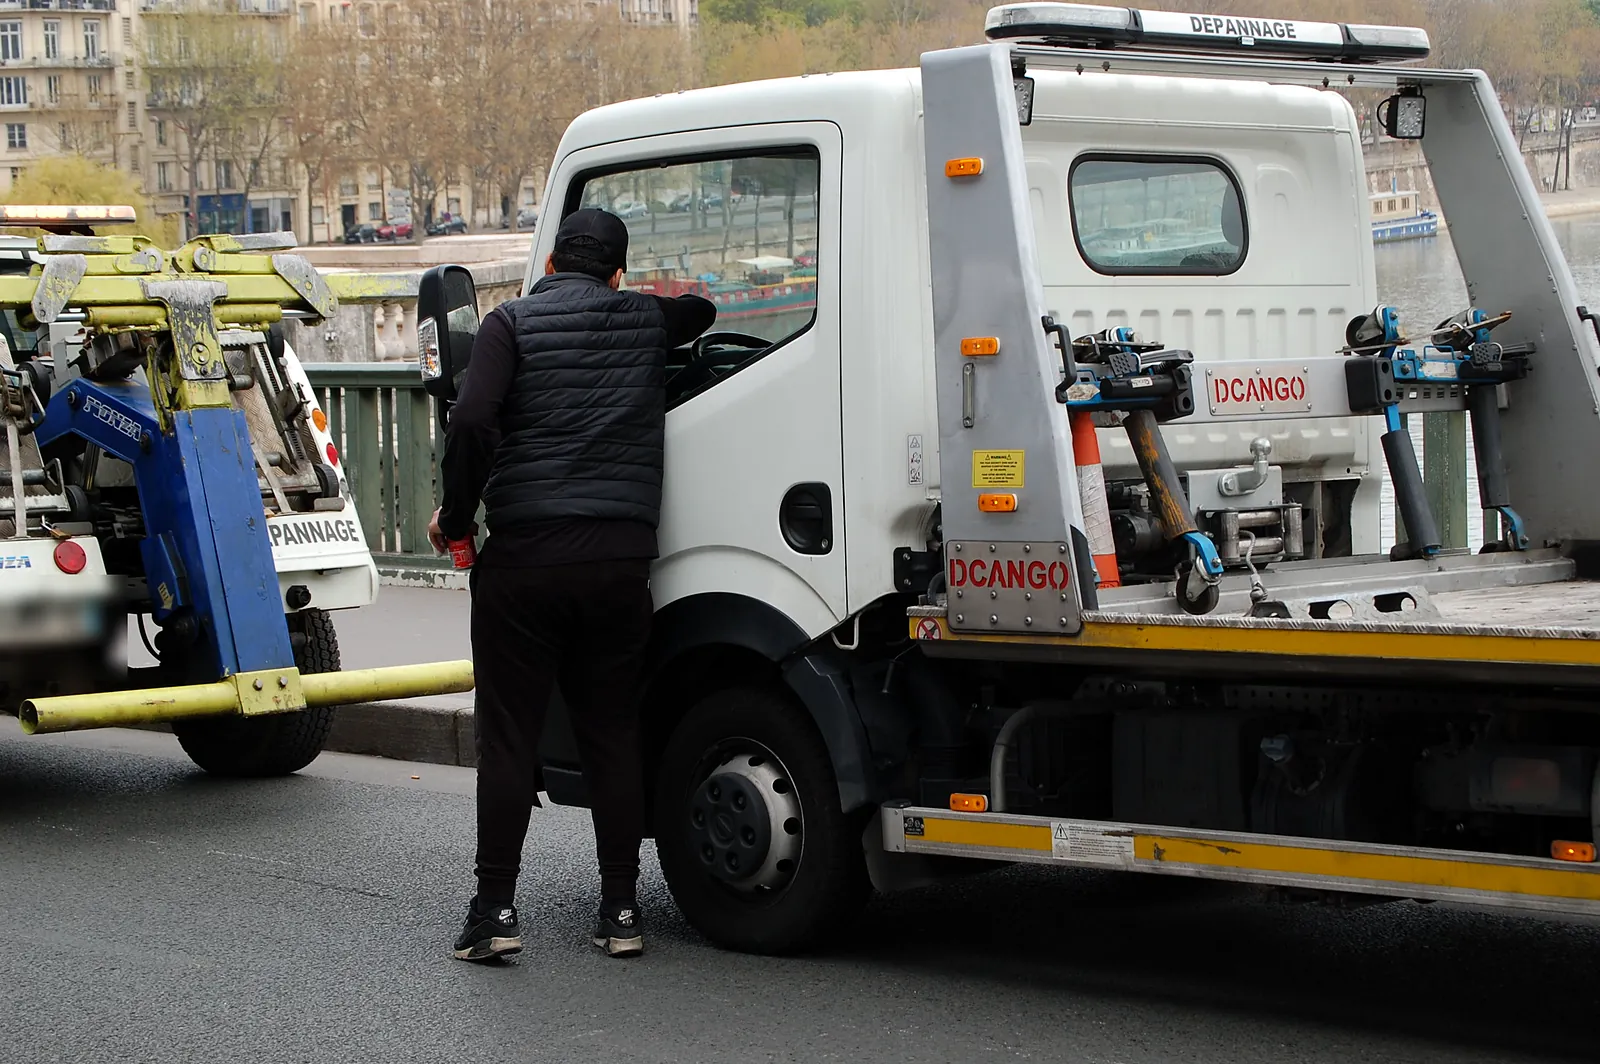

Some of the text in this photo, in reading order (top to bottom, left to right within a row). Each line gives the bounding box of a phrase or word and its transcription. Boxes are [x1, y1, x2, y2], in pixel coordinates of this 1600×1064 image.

[1190, 16, 1296, 39] DEPANNAGE
[1215, 376, 1305, 403] DCANGO
[269, 519, 360, 547] PANNAGE
[949, 558, 1069, 590] DCANGO
